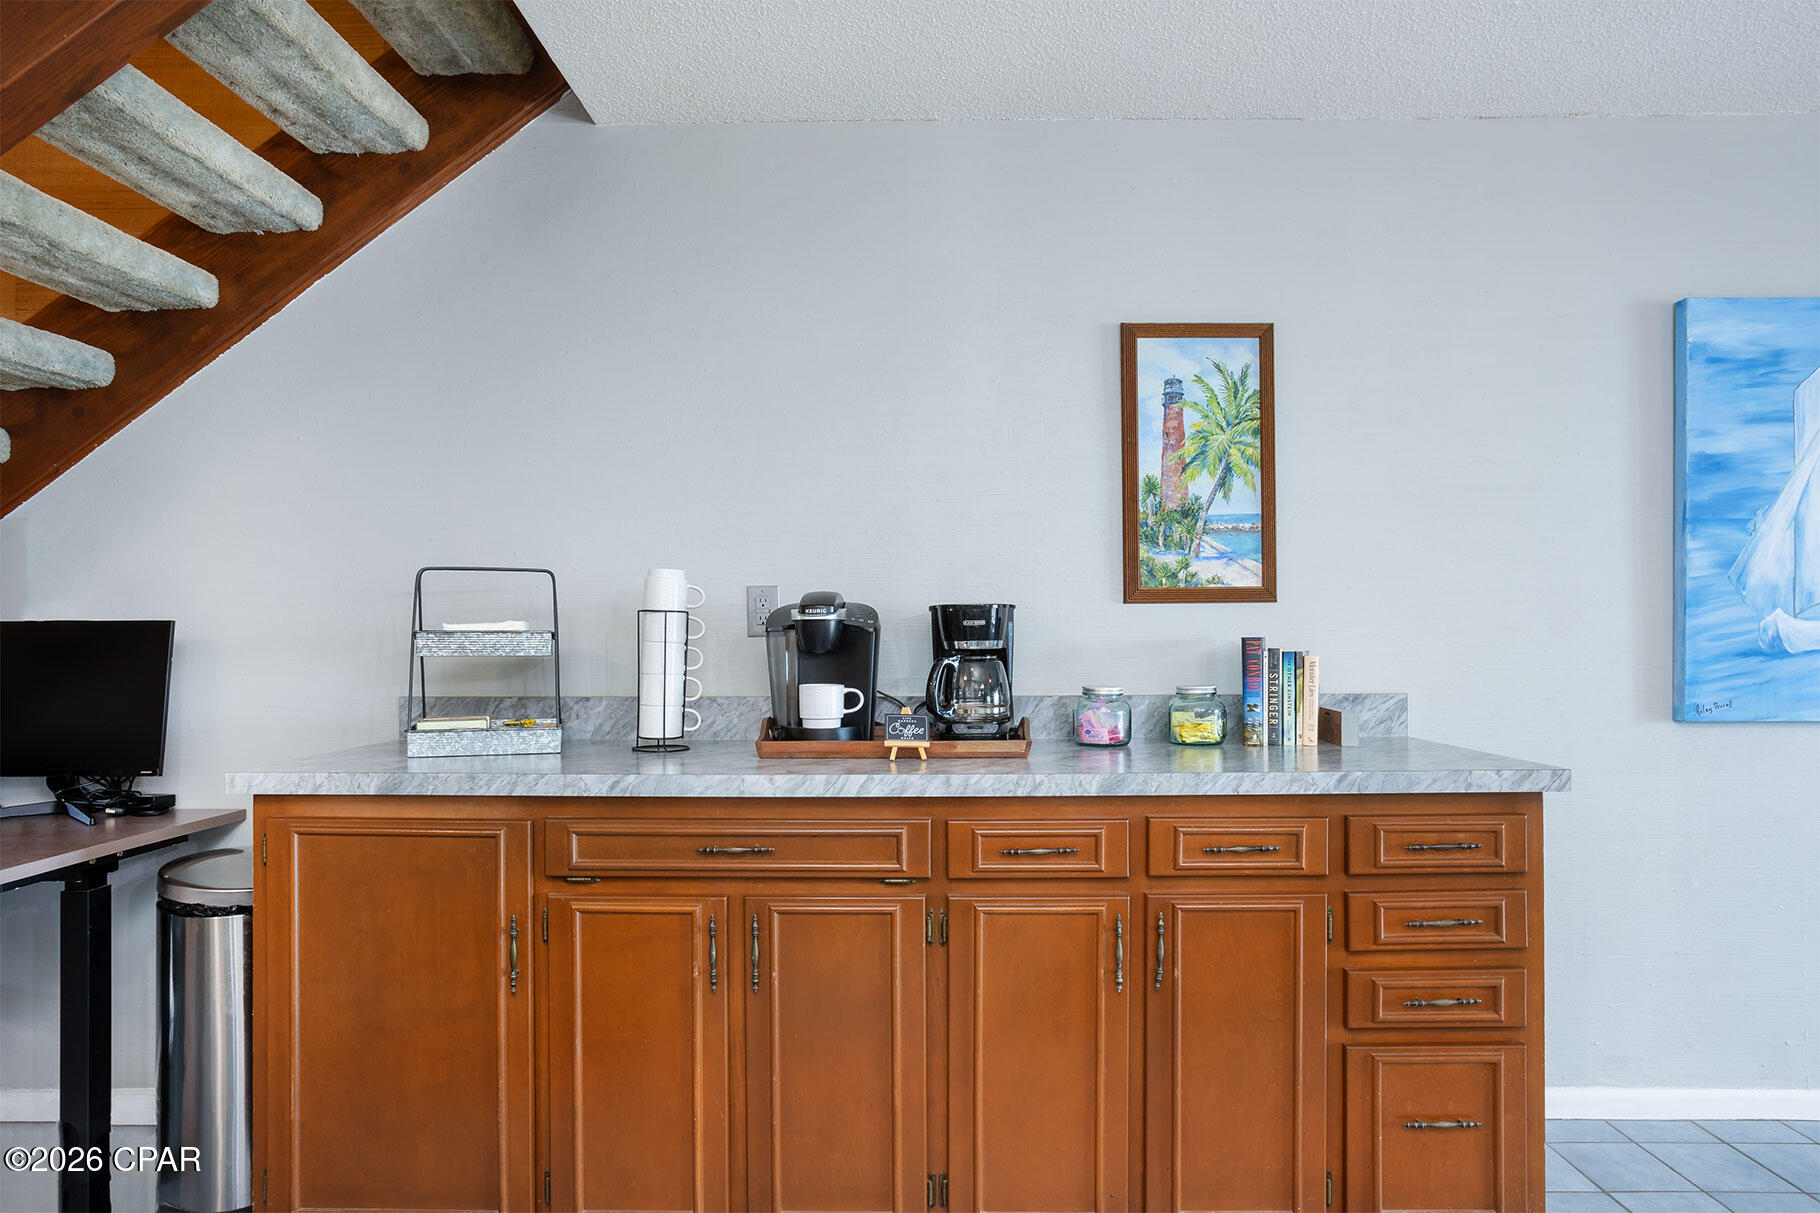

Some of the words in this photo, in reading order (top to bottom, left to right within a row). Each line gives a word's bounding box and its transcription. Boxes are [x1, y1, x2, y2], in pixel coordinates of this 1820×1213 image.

[1245, 640, 1261, 655] PAT
[1246, 659, 1261, 692] CONROY
[1269, 672, 1279, 725] STRINGER
[889, 722, 925, 737] Coffee
